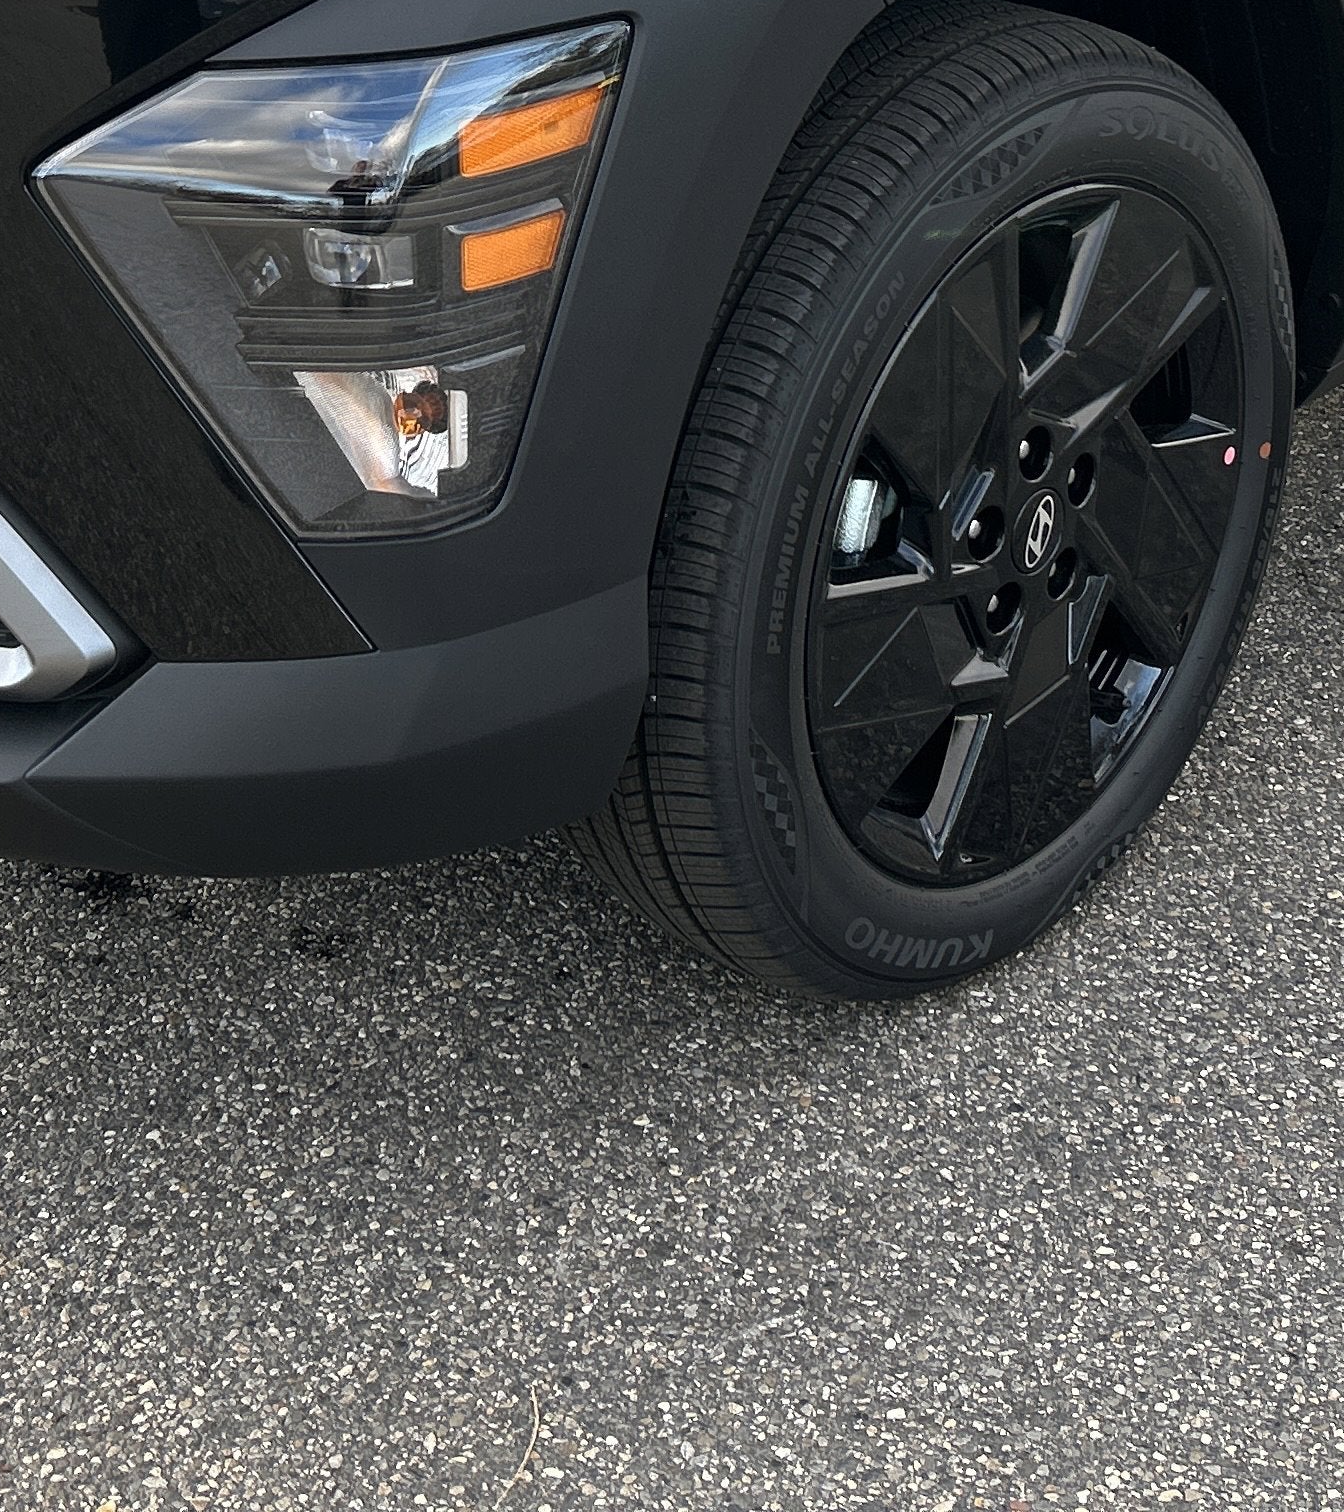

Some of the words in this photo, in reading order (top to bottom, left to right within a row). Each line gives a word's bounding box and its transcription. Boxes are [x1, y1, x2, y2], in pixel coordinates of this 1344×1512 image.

[1097, 104, 1225, 173] SOLUS
[766, 484, 809, 655] PREMIUM
[804, 270, 906, 479] ALL-SEASON
[844, 915, 995, 971] KUMHO
